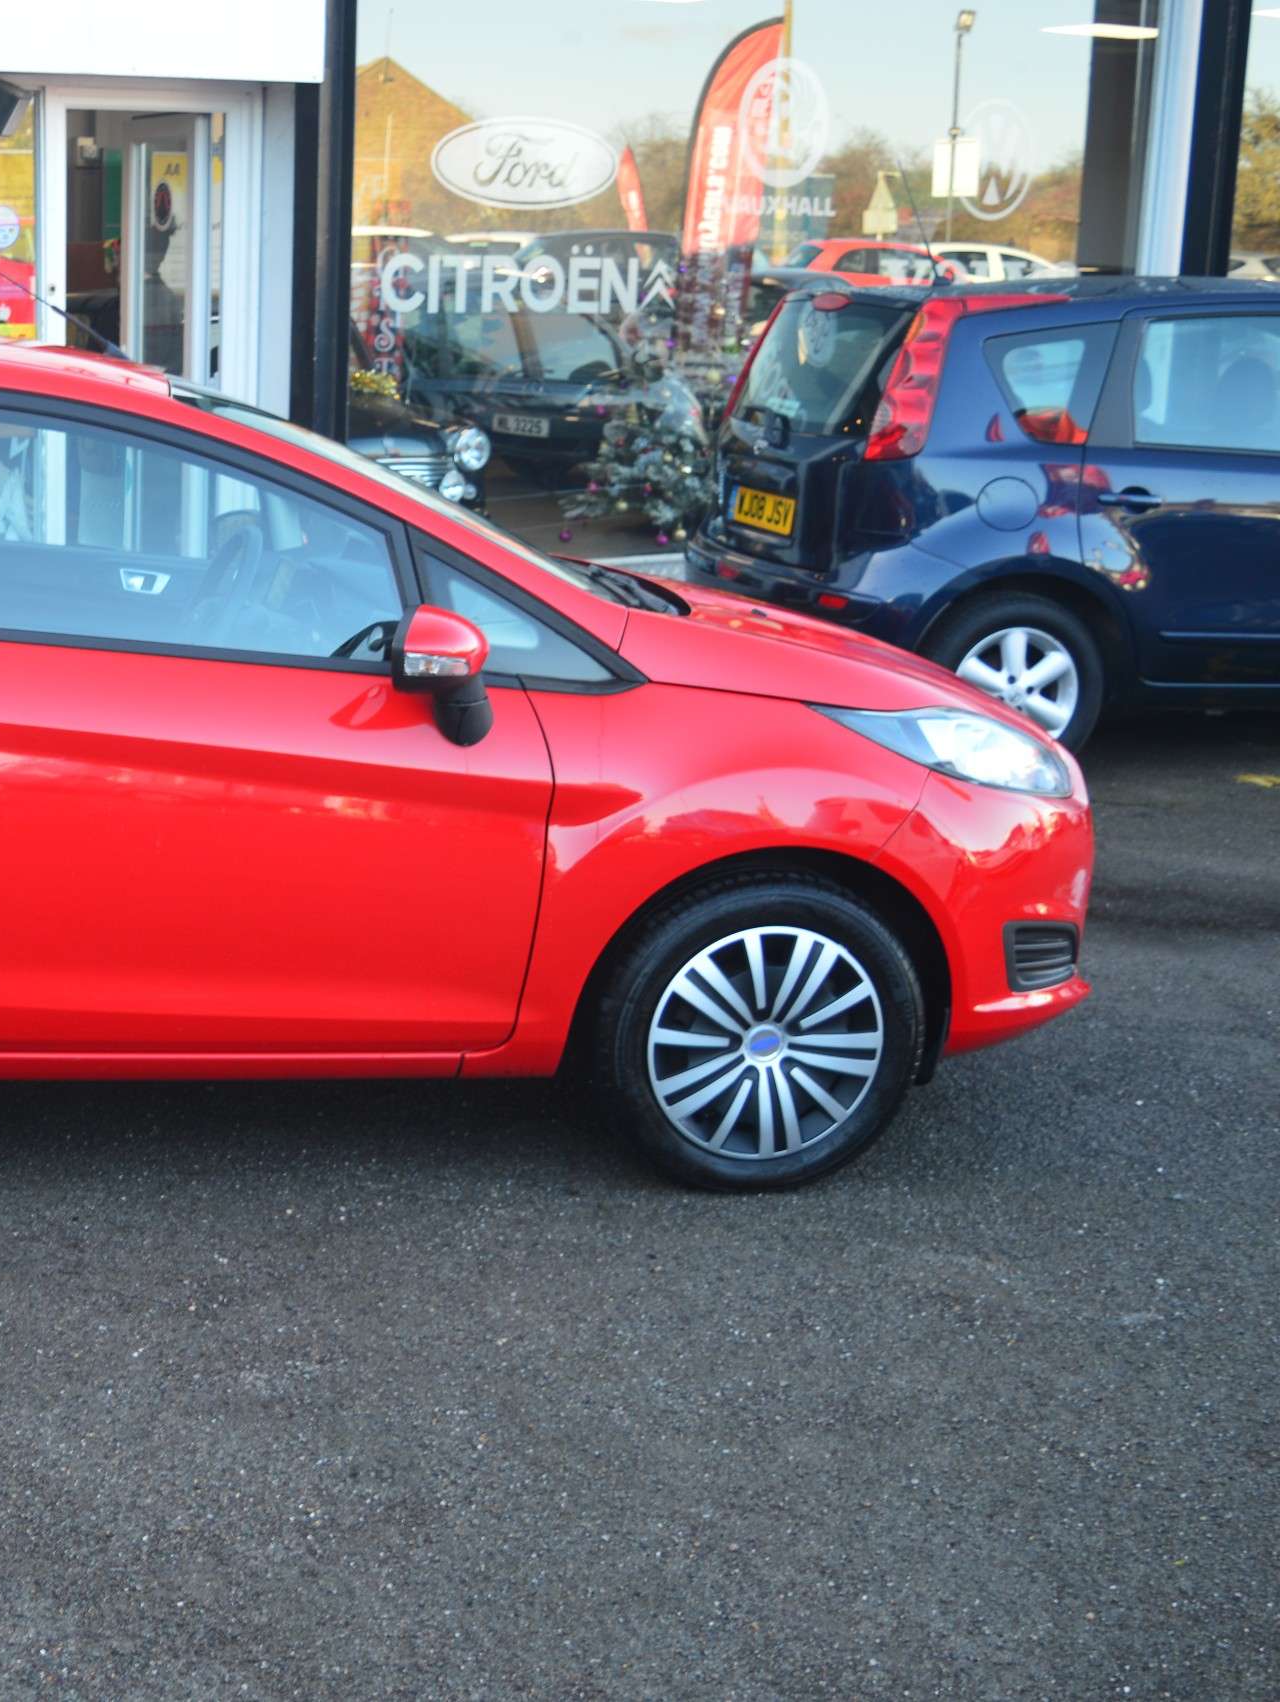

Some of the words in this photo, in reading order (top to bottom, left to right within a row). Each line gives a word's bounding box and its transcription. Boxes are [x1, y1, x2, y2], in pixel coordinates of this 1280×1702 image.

[474, 132, 578, 188] Ford
[723, 195, 837, 217] VAUXHALL
[380, 244, 639, 314] CITROËN
